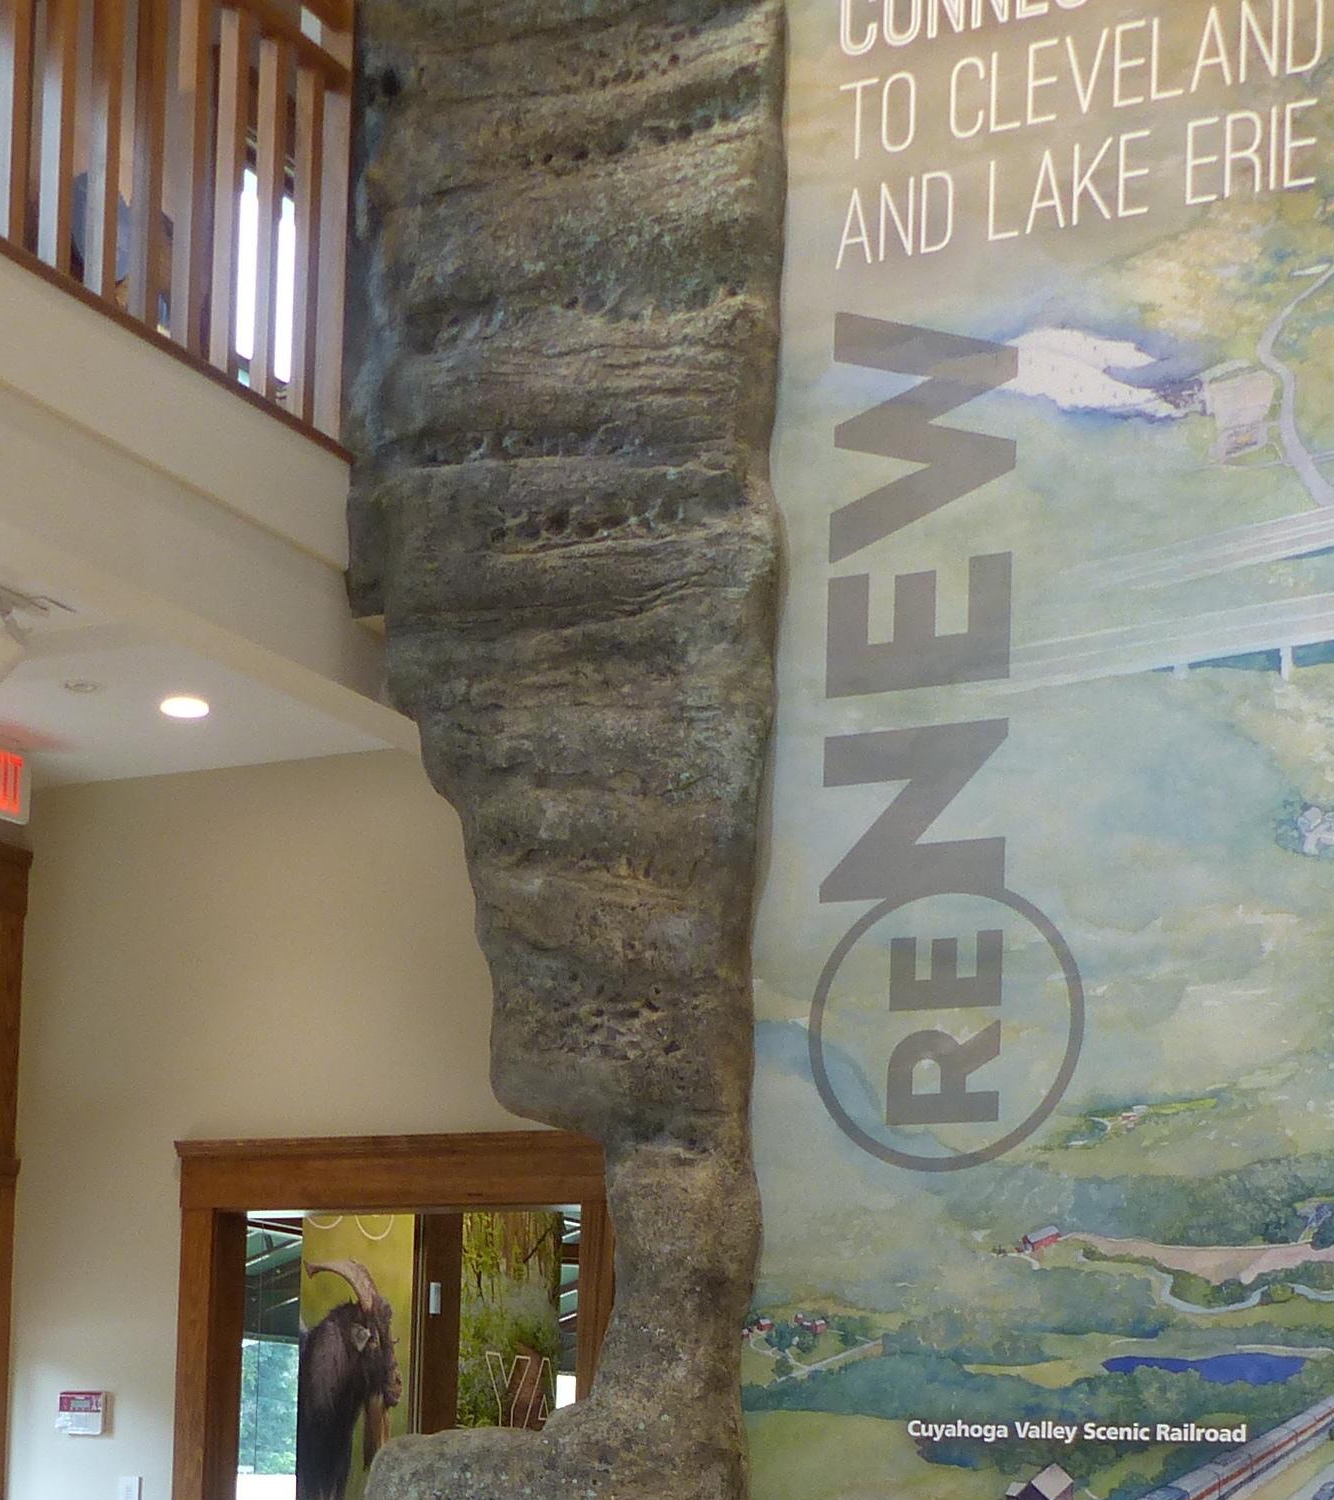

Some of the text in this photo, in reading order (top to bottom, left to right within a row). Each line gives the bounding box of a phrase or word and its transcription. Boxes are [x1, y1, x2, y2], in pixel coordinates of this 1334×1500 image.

[839, 0, 1325, 159] TO CLEVELAND
[836, 98, 1318, 270] AND LAKE ERIE
[906, 1419, 1247, 1443] Cuyahoga Valley Scenic Railroad
